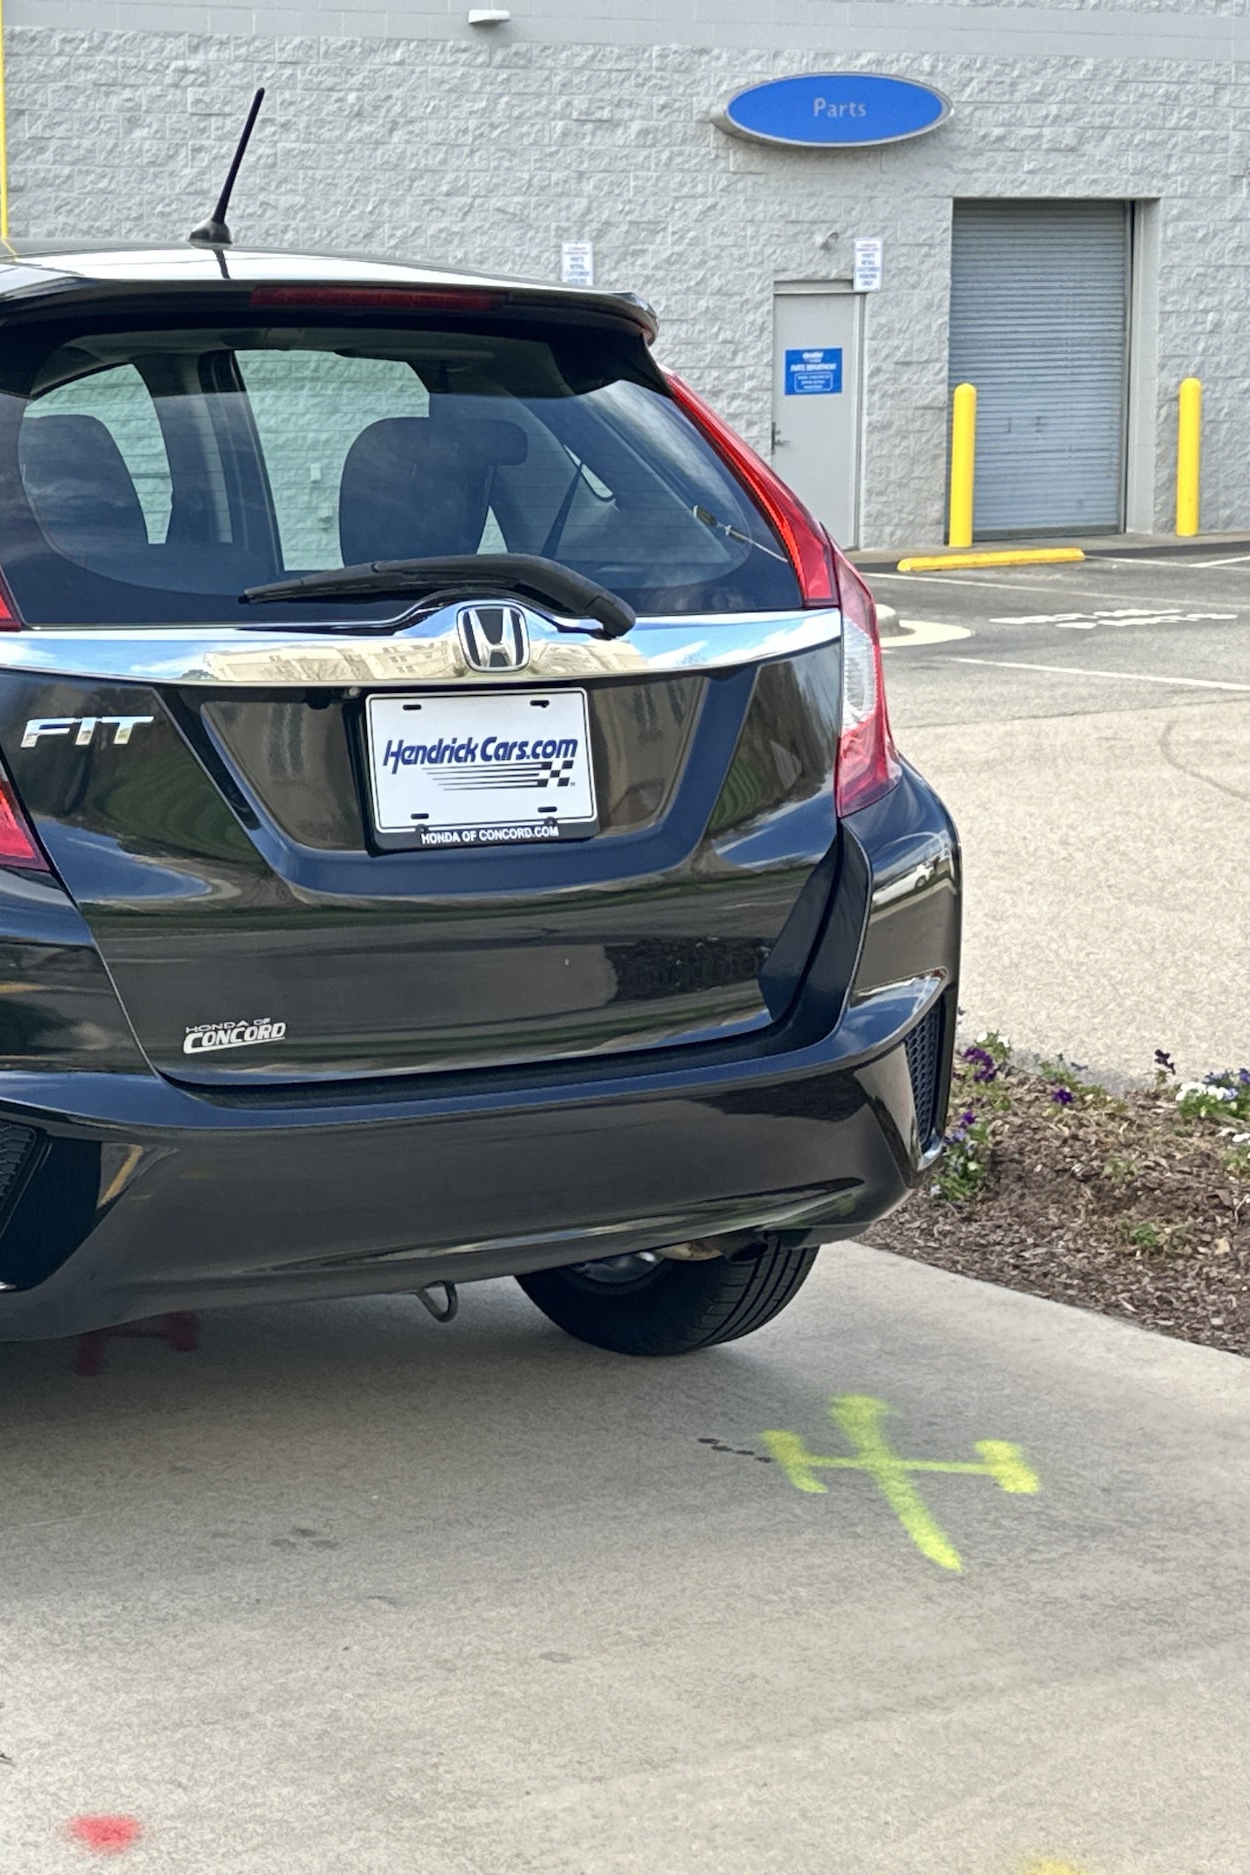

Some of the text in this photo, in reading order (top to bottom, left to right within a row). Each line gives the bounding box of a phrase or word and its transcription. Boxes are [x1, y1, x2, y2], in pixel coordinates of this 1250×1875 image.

[813, 97, 867, 117] Parts
[20, 716, 154, 748] FIT
[420, 824, 559, 845] HONDA OF CONCORD.COM
[185, 1020, 249, 1033] HONDA
[183, 1022, 287, 1054] CONCORD
